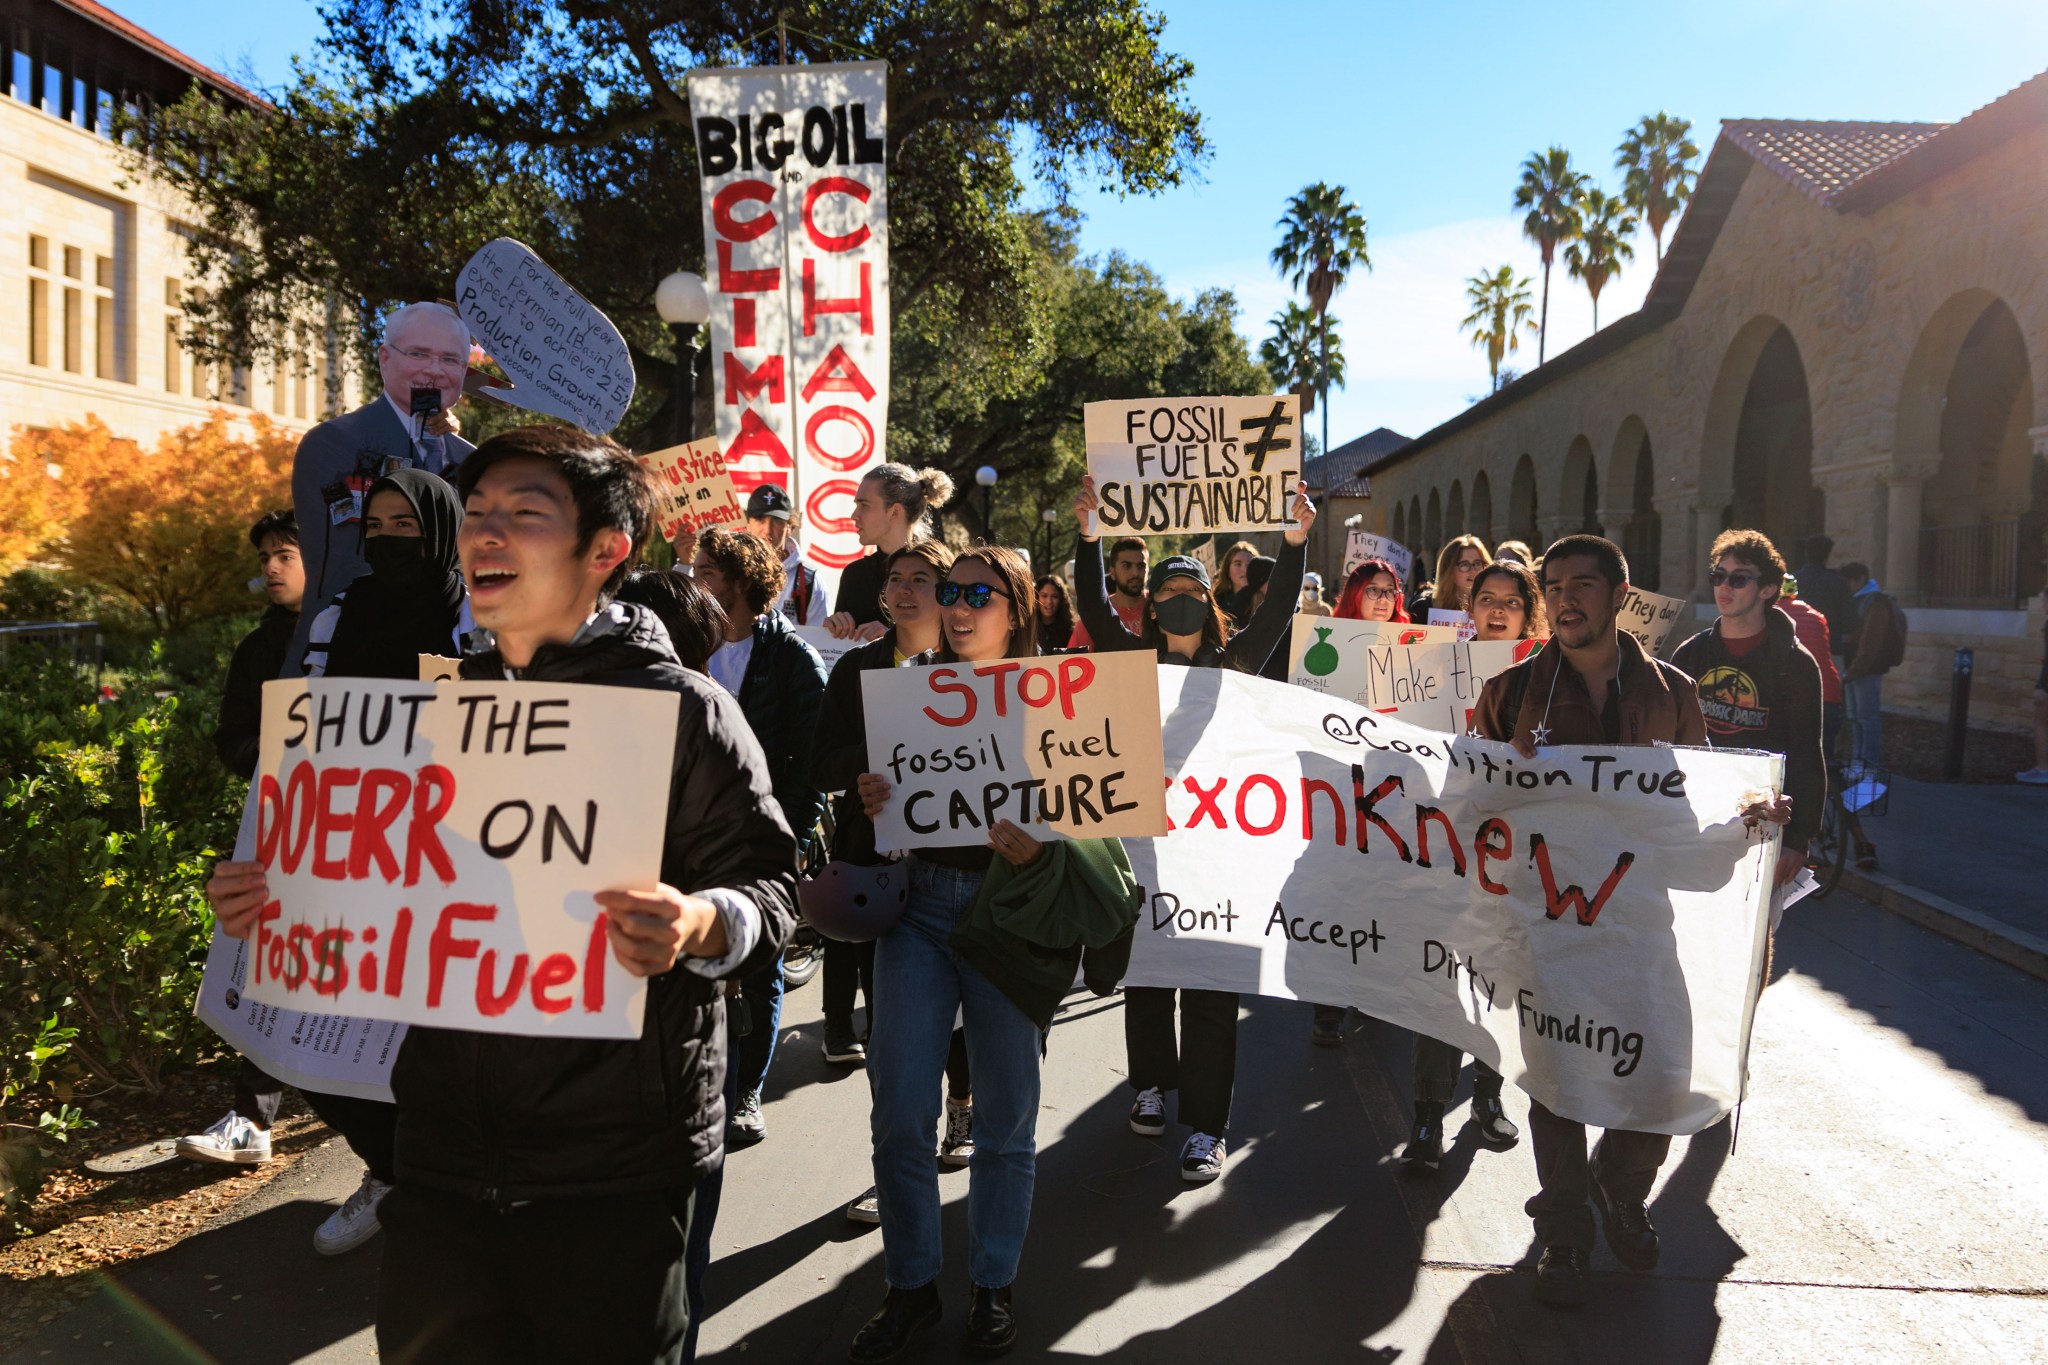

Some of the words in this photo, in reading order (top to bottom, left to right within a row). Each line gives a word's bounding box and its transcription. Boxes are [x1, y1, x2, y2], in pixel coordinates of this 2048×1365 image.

[697, 112, 794, 177] BIG
[802, 103, 883, 168] OIL
[779, 170, 802, 184] AND
[468, 266, 515, 315] expect
[520, 312, 534, 331] to
[543, 336, 595, 379] achieve
[482, 249, 504, 279] the
[507, 275, 564, 337] Permian
[614, 369, 631, 387] we
[519, 256, 542, 282] For
[542, 279, 559, 301] the
[564, 295, 587, 322] full
[584, 317, 614, 345] year
[460, 286, 541, 370] Production
[548, 364, 602, 414] Growth
[483, 338, 498, 355] the
[502, 355, 533, 382] second
[536, 380, 583, 416] consecutive
[1126, 405, 1239, 444] FOSSIL
[696, 487, 711, 500] an
[1136, 443, 1239, 480] FUELS
[1098, 471, 1299, 532] SUSTAINABLE
[1352, 533, 1378, 551] They
[1621, 592, 1656, 624] They
[923, 657, 1096, 727] STOP
[1297, 678, 1329, 688] FOSSIL
[1368, 646, 1437, 704] Make
[284, 691, 437, 757] SHUT
[458, 695, 570, 756] THE
[1732, 707, 1766, 726] PARK
[887, 733, 1005, 784] fossil
[1039, 717, 1120, 769] fuel
[1322, 713, 1572, 789] @Coalition
[1581, 755, 1687, 797] True
[257, 760, 457, 888] DOERR
[480, 799, 598, 865] ON
[904, 771, 1138, 834] CAPTURE
[427, 902, 608, 1017] Fuel
[1151, 892, 1240, 933] Don't
[1265, 901, 1386, 965] Accept
[1423, 939, 1496, 1012] Dirty
[1517, 988, 1644, 1077] Funding
